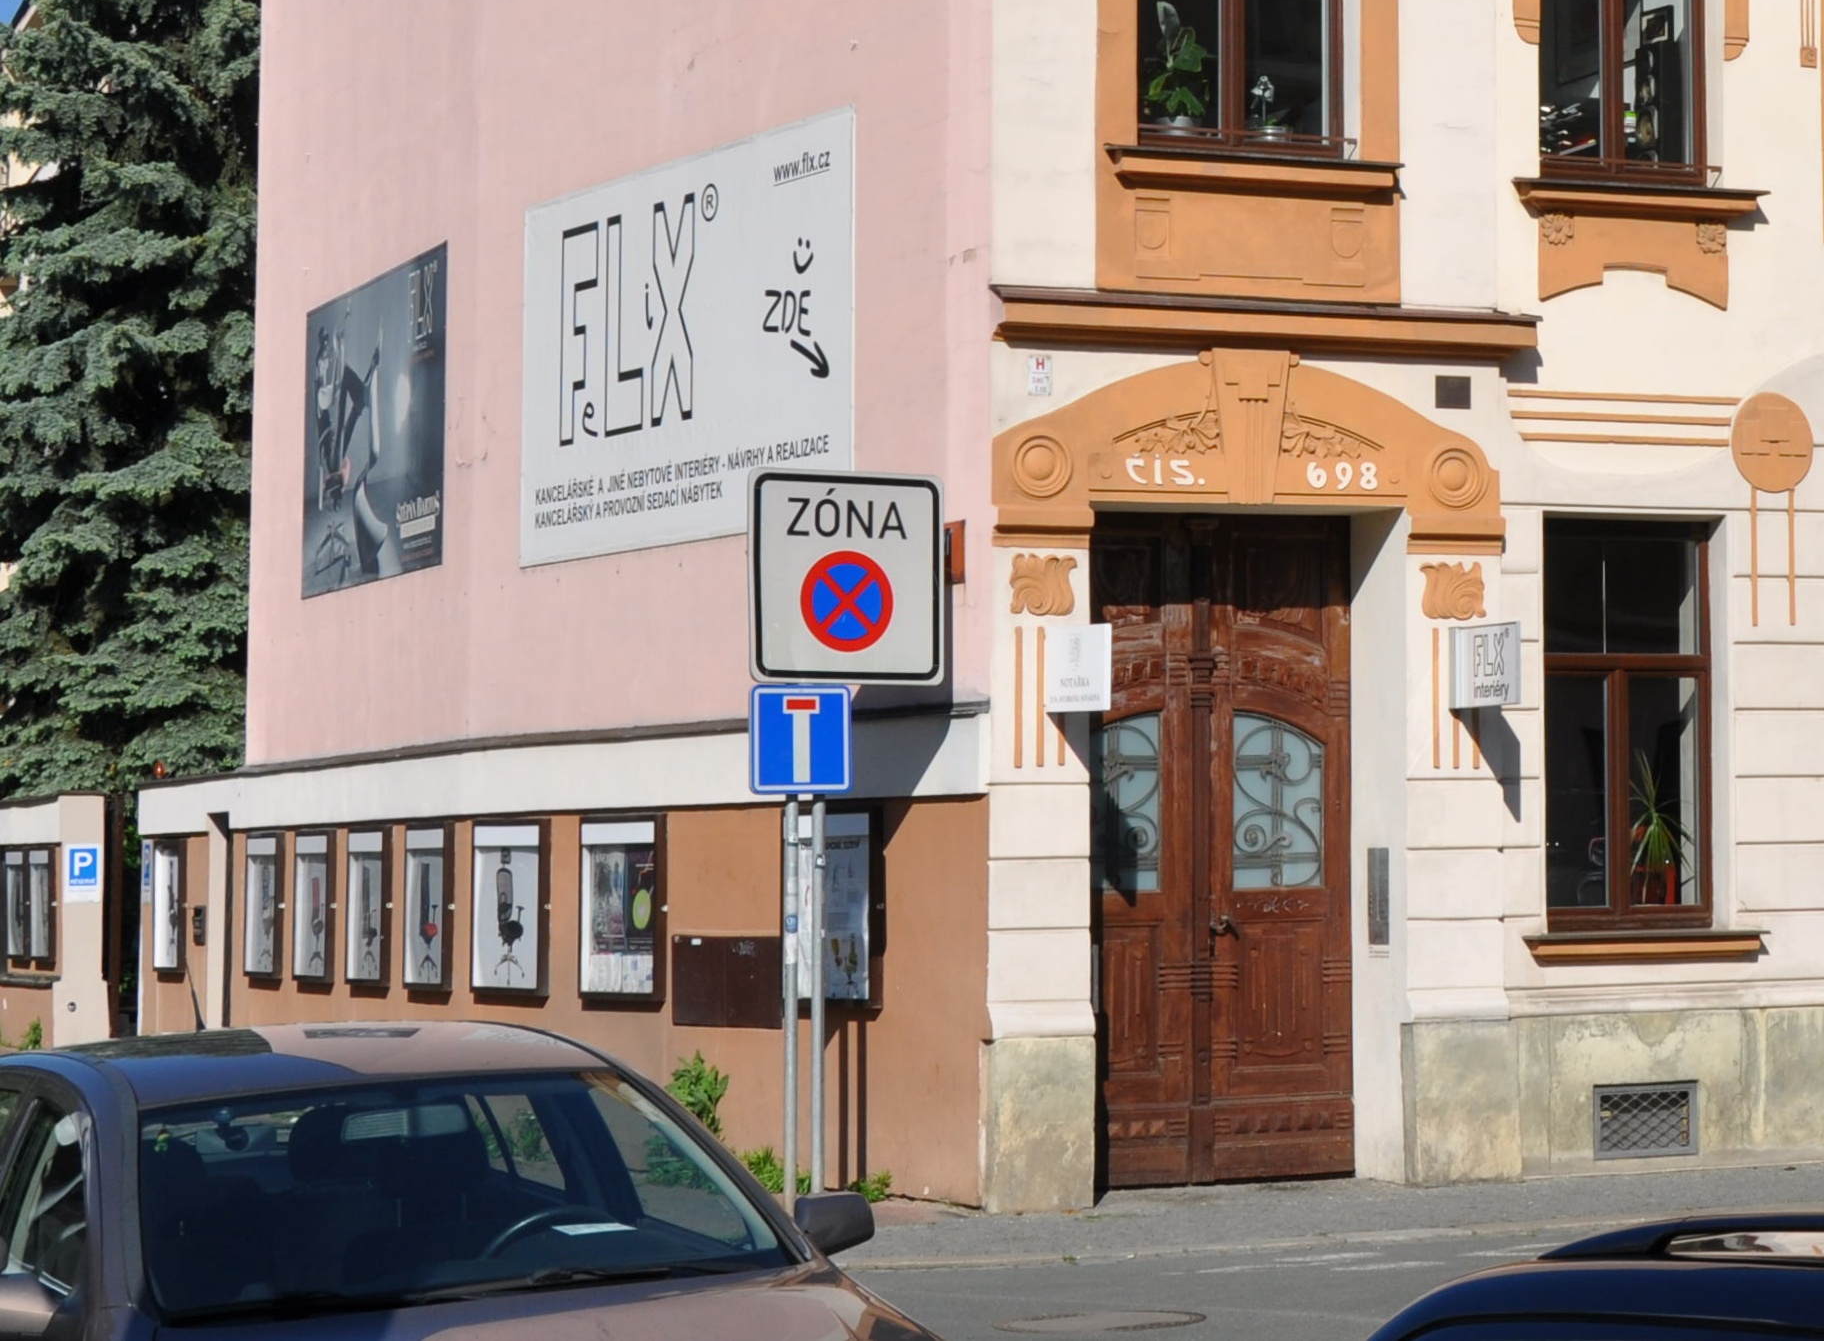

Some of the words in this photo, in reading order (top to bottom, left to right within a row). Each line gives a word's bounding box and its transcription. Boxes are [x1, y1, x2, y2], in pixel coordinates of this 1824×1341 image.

[773, 151, 830, 182] www.flx.cz
[762, 290, 811, 337] ZDE
[535, 474, 594, 505] KANCELÁŘSKÉ
[597, 478, 604, 494] A
[607, 469, 625, 492] JINÉ
[627, 460, 672, 489] NEBYTOVÉ
[674, 453, 721, 480] INTERIÉRY
[727, 447, 765, 470] NÁVRHY
[767, 446, 774, 463] A
[776, 434, 829, 462] REALIZACE
[1306, 461, 1378, 490] 698
[535, 500, 594, 529] KANCELÁŘSKÝ
[595, 504, 602, 519] A
[603, 490, 645, 518] PROVOZNÍ
[646, 484, 679, 511] SEDACÍ
[681, 481, 723, 505] NÁBYTEK
[786, 488, 908, 540] ZÓNA
[1474, 680, 1509, 701] interiéry
[74, 852, 93, 876] P
